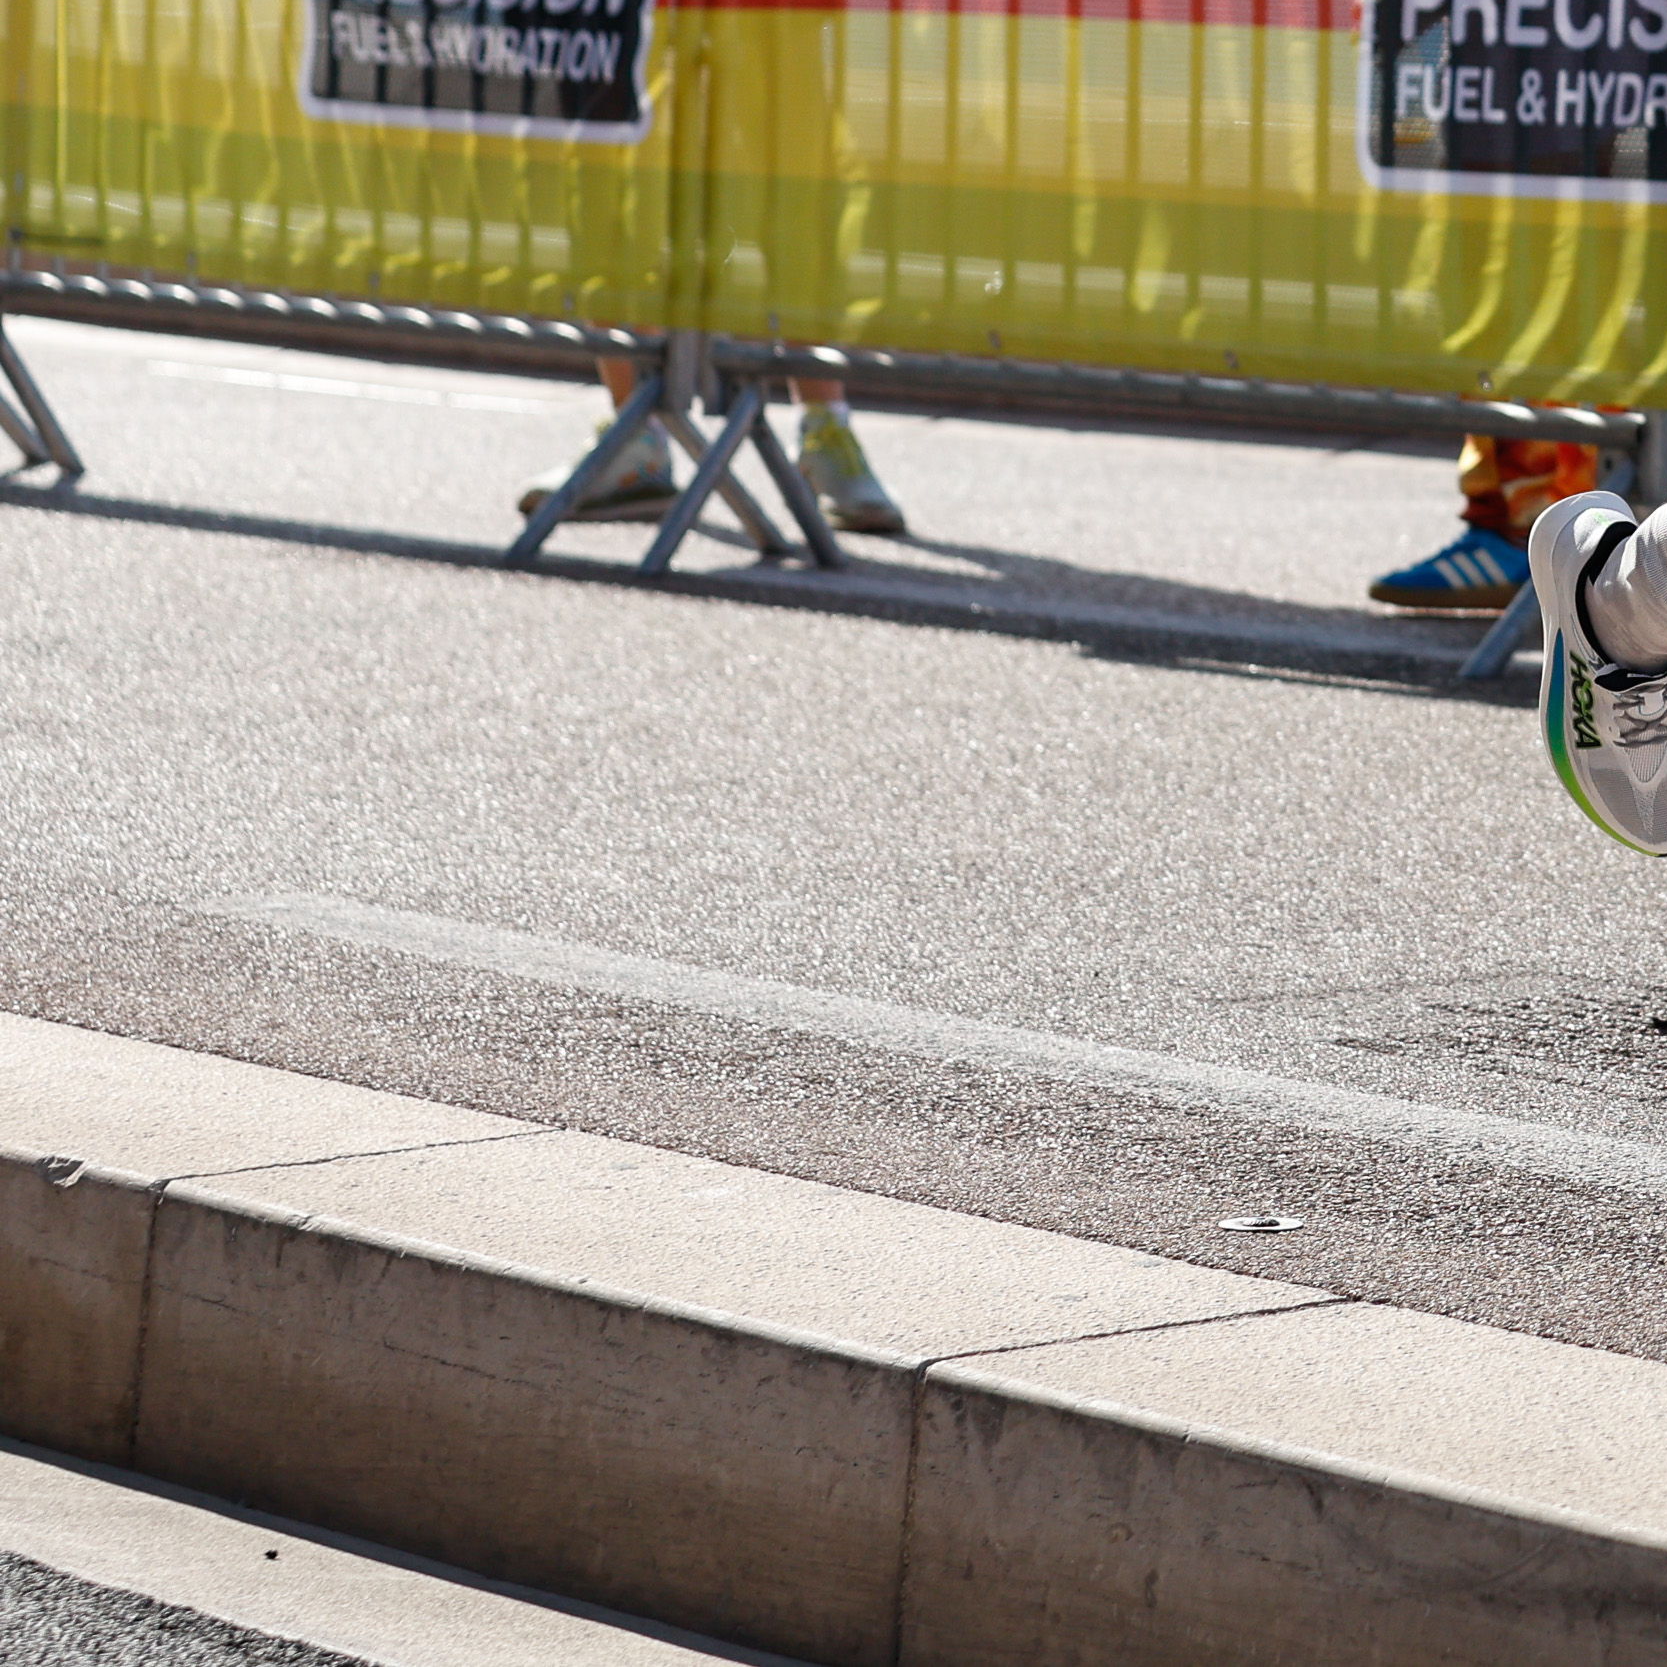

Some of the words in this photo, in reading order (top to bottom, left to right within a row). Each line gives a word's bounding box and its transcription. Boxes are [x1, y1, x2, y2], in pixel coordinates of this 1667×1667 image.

[330, 10, 408, 65] FUEL
[1397, 63, 1506, 123] FUEL
[1516, 68, 1547, 125] &
[1569, 648, 1603, 749] HOKA
